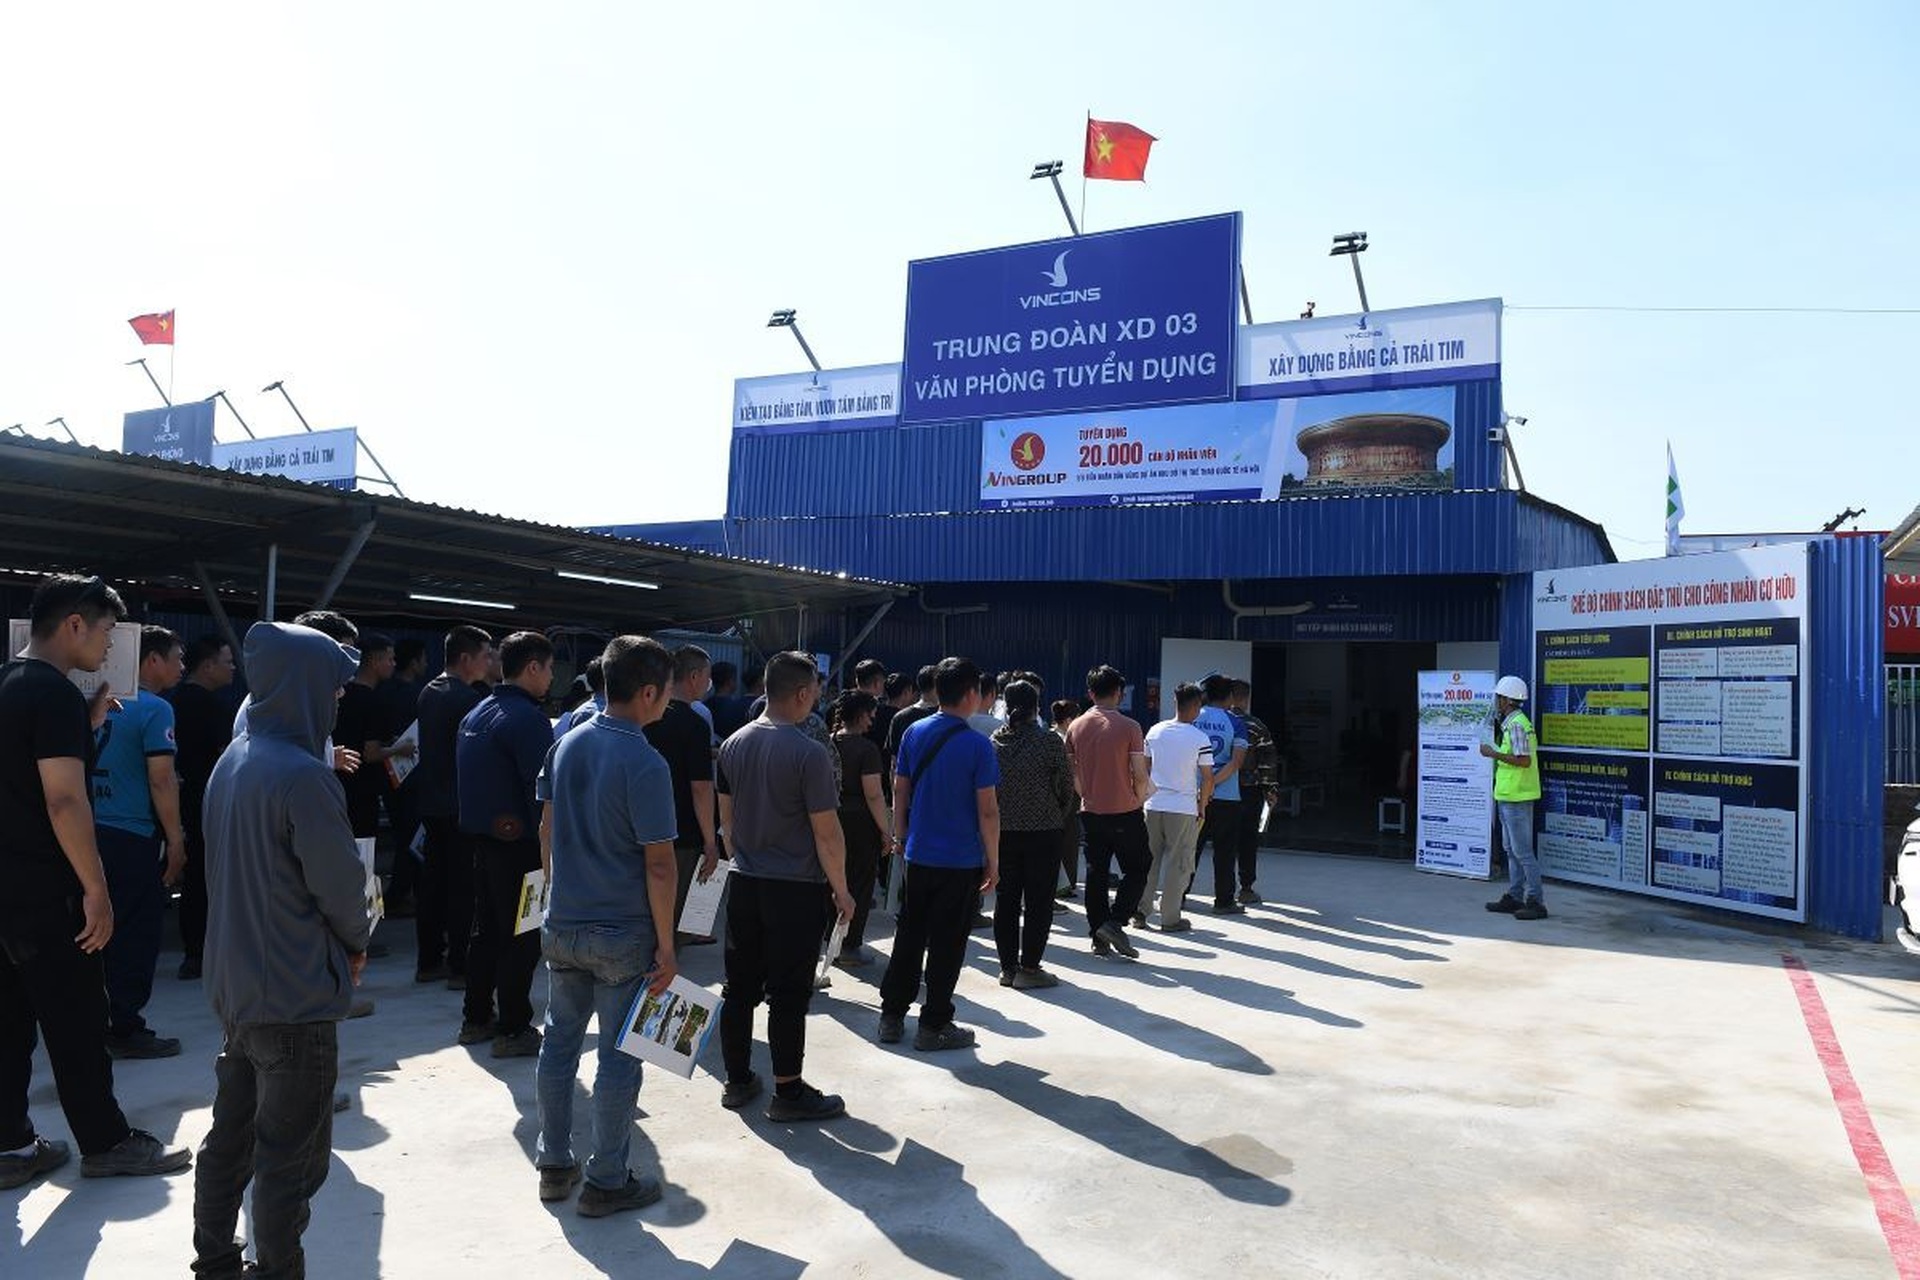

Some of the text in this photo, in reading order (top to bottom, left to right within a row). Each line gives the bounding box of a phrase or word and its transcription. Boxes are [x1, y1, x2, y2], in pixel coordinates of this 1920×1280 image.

[1020, 287, 1101, 309] VINCONS
[933, 312, 1197, 361] TRUNG ĐOÀN XD 03
[1269, 339, 1465, 377] XÂY DỰNG BẰNG CẢ TRÁI TIM
[915, 351, 1216, 401] VĂN PHÒNG TUYỂN DỤNG
[1079, 442, 1143, 468] 20.000
[983, 471, 1067, 489] VINGROUP
[1684, 584, 1702, 607] CHO
[1703, 579, 1729, 605] CÔNG
[1730, 576, 1757, 603] NHÂN
[1759, 576, 1773, 602] CƠ
[1444, 689, 1473, 701] 20.000
